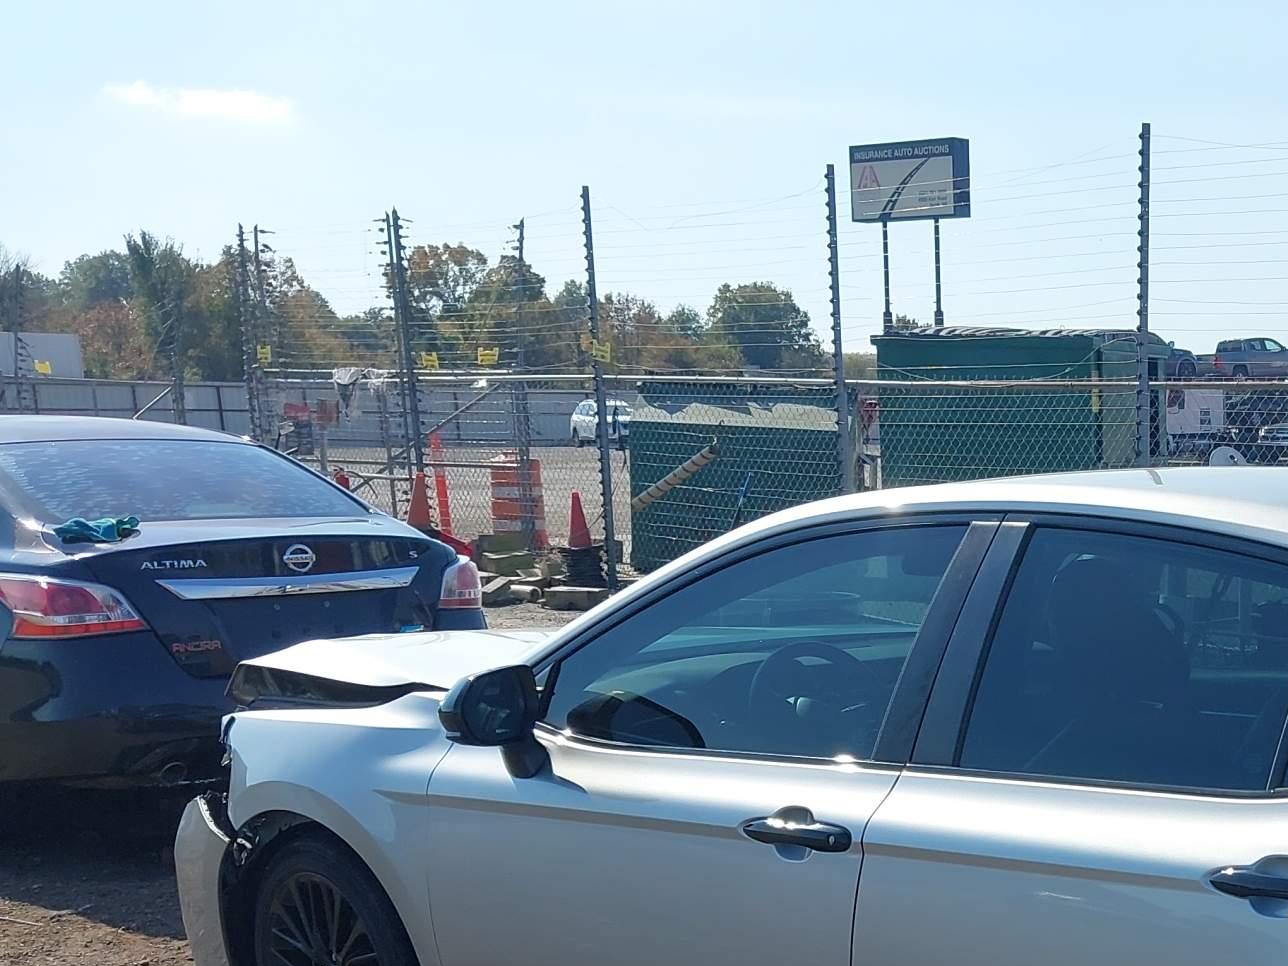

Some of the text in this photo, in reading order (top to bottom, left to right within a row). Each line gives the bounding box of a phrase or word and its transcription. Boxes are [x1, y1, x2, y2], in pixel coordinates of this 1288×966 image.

[853, 144, 949, 160] INSURANCE AUTO AUCTIONS
[407, 550, 419, 559] S
[140, 558, 208, 571] ALTIMA
